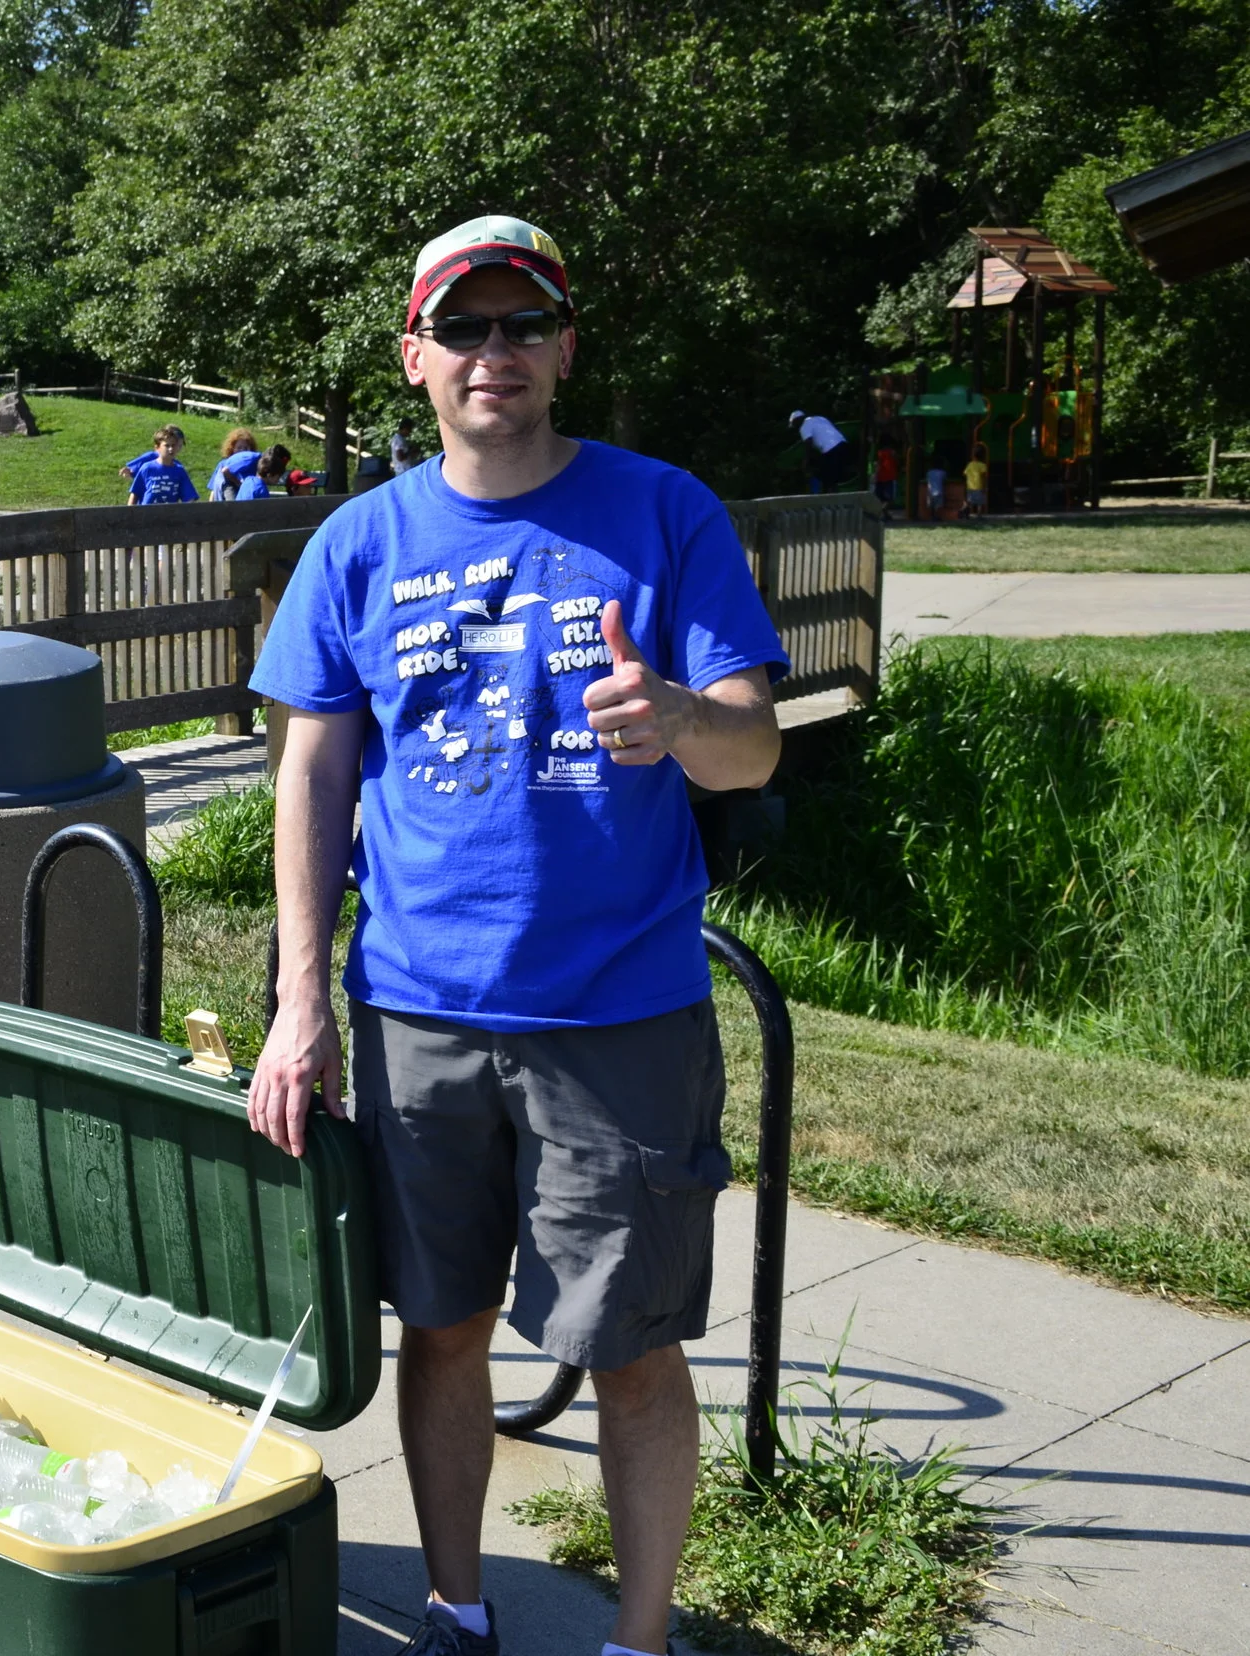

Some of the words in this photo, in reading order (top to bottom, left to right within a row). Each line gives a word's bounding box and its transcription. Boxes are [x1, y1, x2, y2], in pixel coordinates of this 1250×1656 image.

[392, 571, 456, 604] WALK,
[464, 556, 513, 587] RUN,
[550, 596, 604, 624] SKIP,
[396, 621, 451, 653] HOP,
[463, 631, 497, 644] HERO
[499, 631, 519, 642] UP
[562, 620, 601, 646] FLY,
[397, 648, 468, 681] RIDE,
[551, 730, 594, 750] FOR
[537, 756, 598, 780] JANSEN'S
